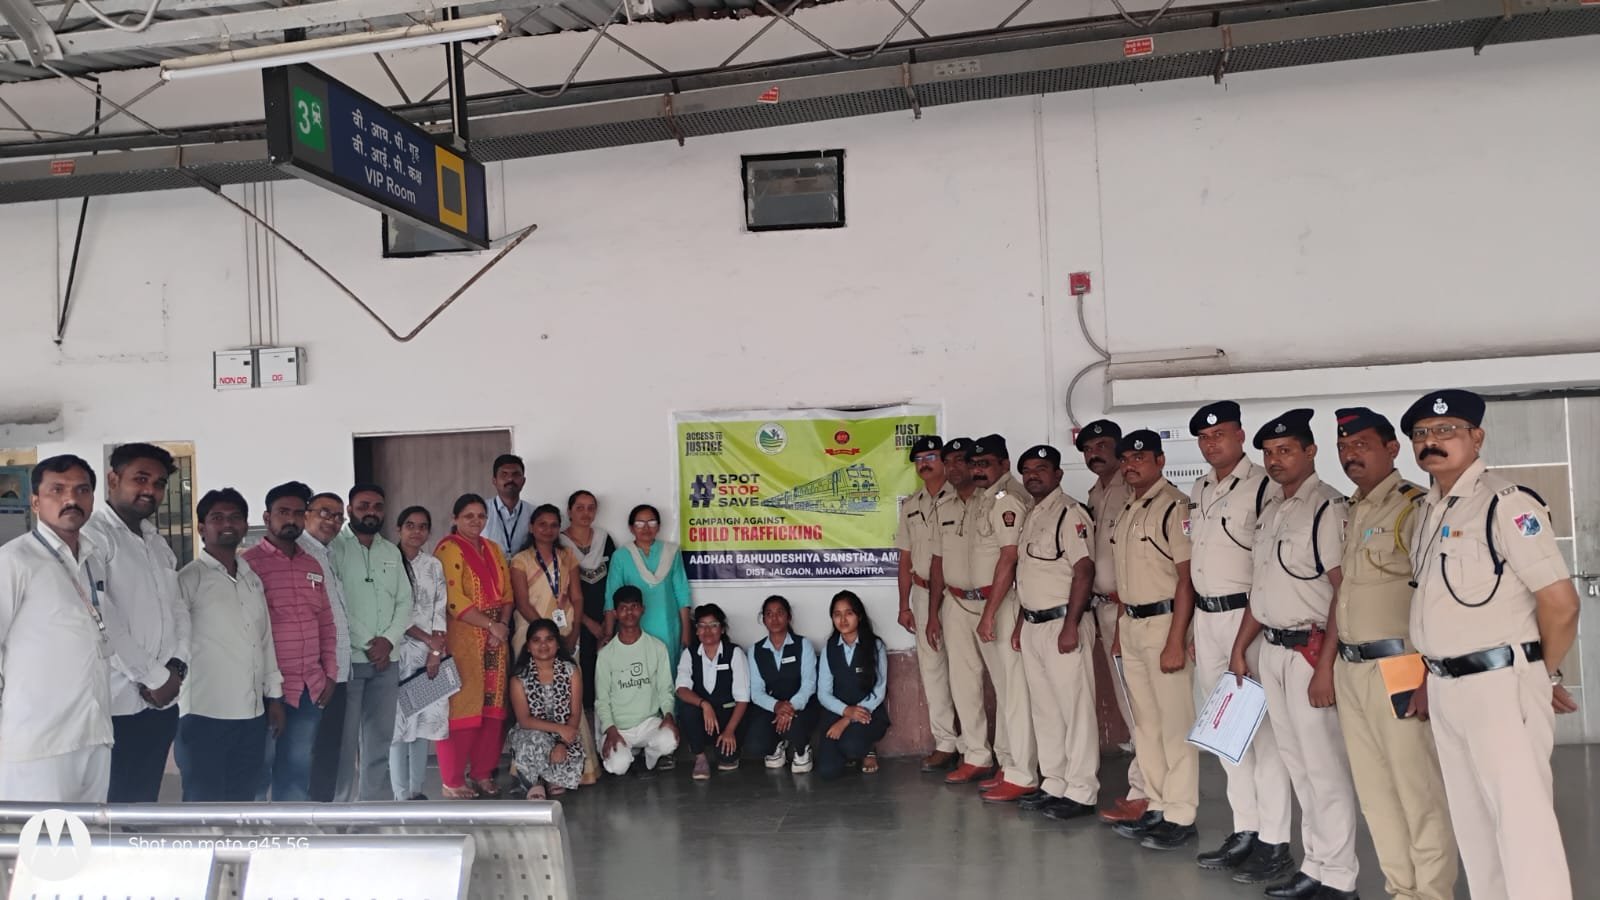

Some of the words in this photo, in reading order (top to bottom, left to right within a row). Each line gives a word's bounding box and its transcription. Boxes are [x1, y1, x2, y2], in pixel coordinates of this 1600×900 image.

[298, 100, 311, 134] 3
[364, 165, 384, 188] VIP
[386, 176, 416, 205] Room
[895, 424, 920, 435] JUST
[718, 474, 760, 484] SPOT
[718, 485, 760, 496] STOP
[718, 497, 760, 508] SAVE
[688, 517, 740, 526] CAMPAIGN
[744, 516, 786, 524] AGAINST
[689, 526, 729, 542] CHILD
[732, 525, 823, 542] TRAFFICKING
[690, 554, 734, 564] AADHAR
[736, 552, 820, 564] BAHUUDESHIYA
[823, 552, 878, 564] SANSTHA,
[768, 568, 814, 576] JALGAON,
[816, 566, 884, 576] MAHARASHTRA
